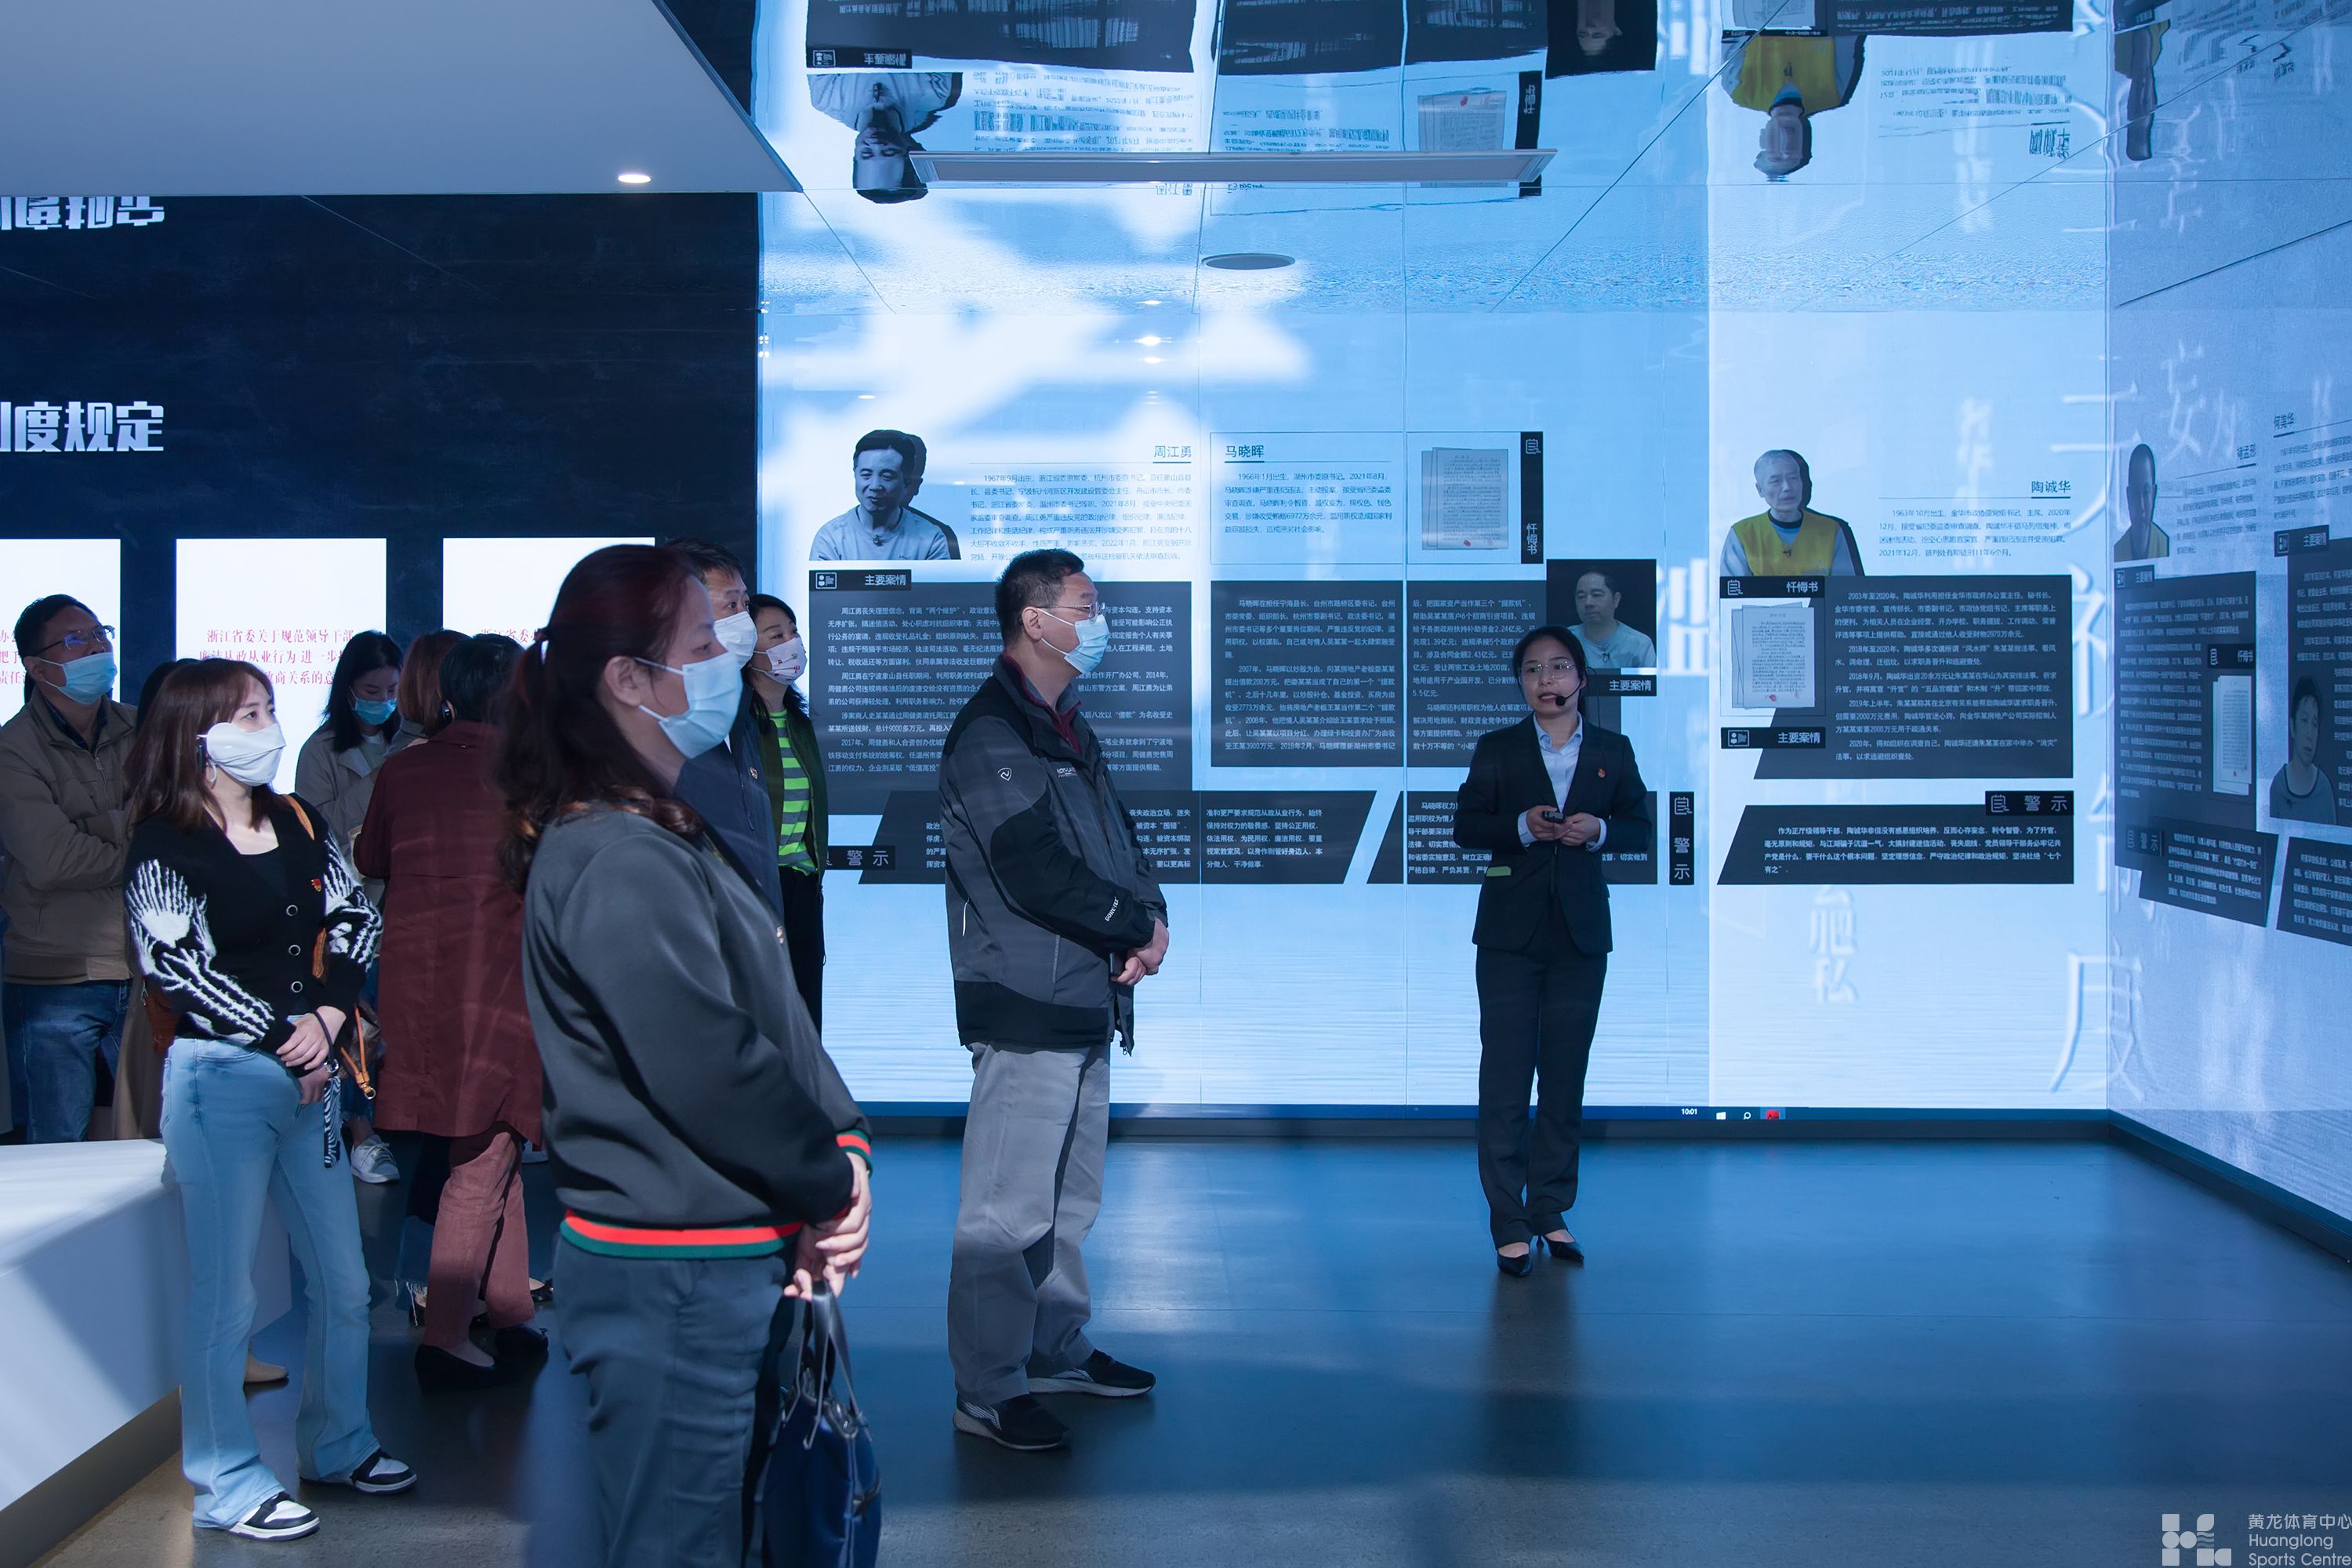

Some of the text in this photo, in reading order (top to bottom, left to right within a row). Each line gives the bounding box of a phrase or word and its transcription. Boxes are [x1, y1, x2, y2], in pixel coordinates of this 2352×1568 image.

[0, 401, 164, 452] 度规定
[1153, 445, 1192, 459] 周江勇
[1225, 445, 1265, 458] 马晓晖
[2031, 480, 2071, 493] 陶诚华
[865, 575, 906, 586] 主要案情
[1786, 581, 1819, 593] 忏悔书
[0, 670, 26, 684] 责任
[267, 670, 334, 684] 商关系的意
[1609, 680, 1652, 691] 主要案情
[1777, 732, 1821, 744] 主要案情
[2024, 795, 2068, 812] 警示
[926, 822, 942, 830] 政治
[847, 850, 889, 866] 警示
[1674, 837, 1690, 880] 警示
